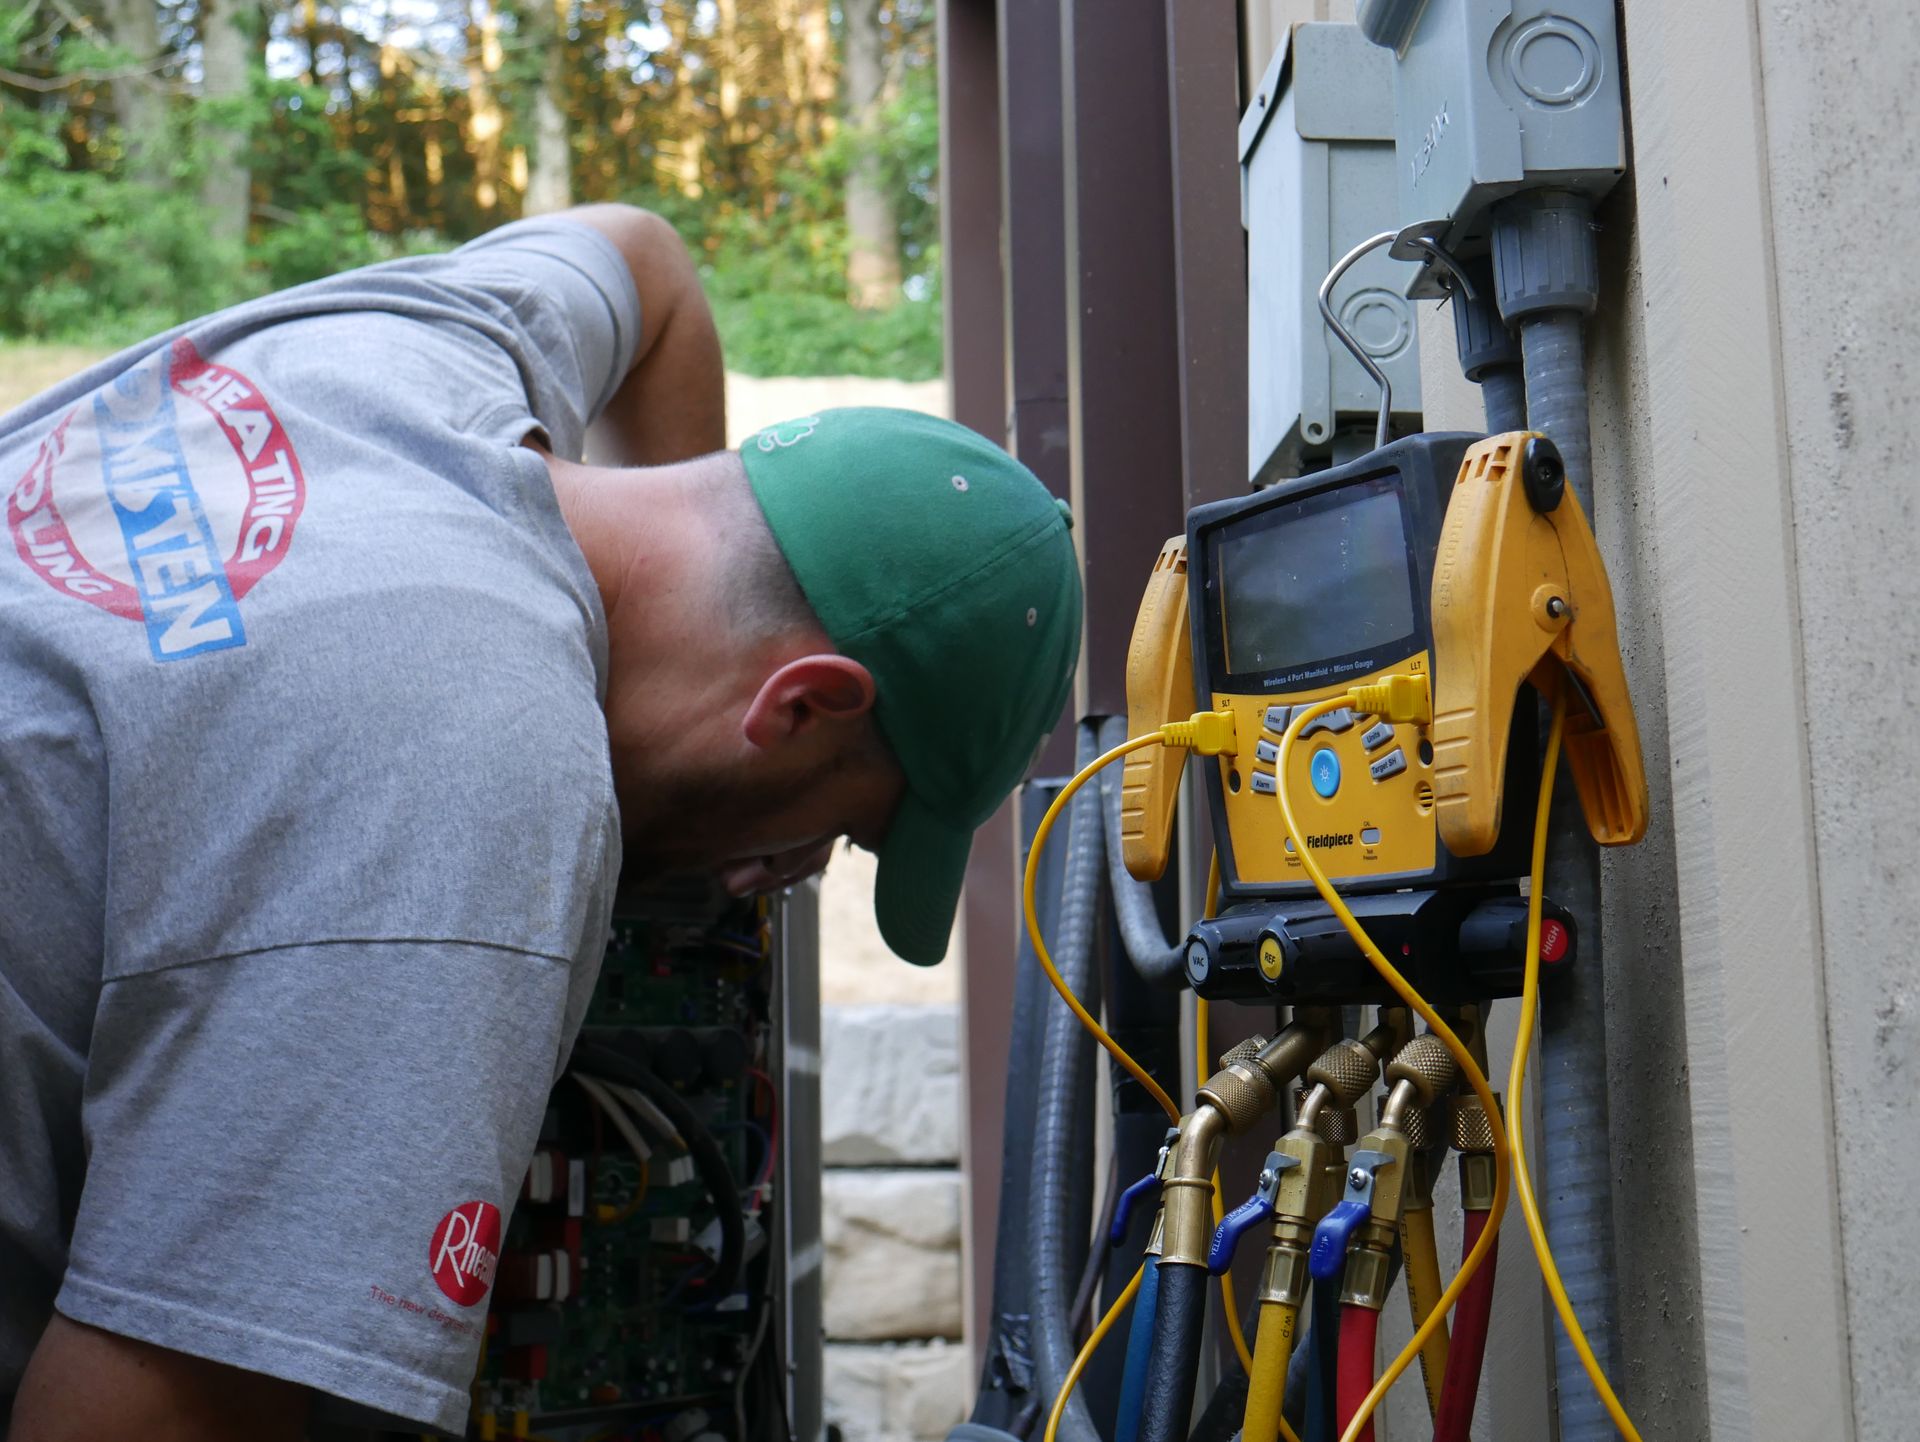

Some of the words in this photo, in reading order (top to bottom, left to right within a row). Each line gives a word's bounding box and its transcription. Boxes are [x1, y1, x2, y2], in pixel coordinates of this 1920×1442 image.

[177, 368, 297, 564] HEATING
[1410, 660, 1421, 671] LLT
[1263, 676, 1287, 688] Wireless
[1292, 672, 1304, 682] Port
[1304, 668, 1329, 679] Manifold
[1333, 663, 1354, 673] Micron
[1354, 660, 1374, 669] Gauge
[1221, 699, 1231, 708] SLT
[1267, 714, 1281, 724] Enter
[1366, 730, 1381, 744] Units
[1371, 761, 1388, 775] Target
[1388, 757, 1397, 767] SH
[1255, 779, 1270, 789] Alarm
[1306, 832, 1354, 849] Fieldpiece
[1542, 925, 1560, 956] HIGH
[1192, 955, 1205, 967] VAC
[1264, 952, 1276, 965] REF
[1210, 1225, 1225, 1257] YELLOW
[369, 1284, 396, 1306] The
[399, 1296, 426, 1315] new
